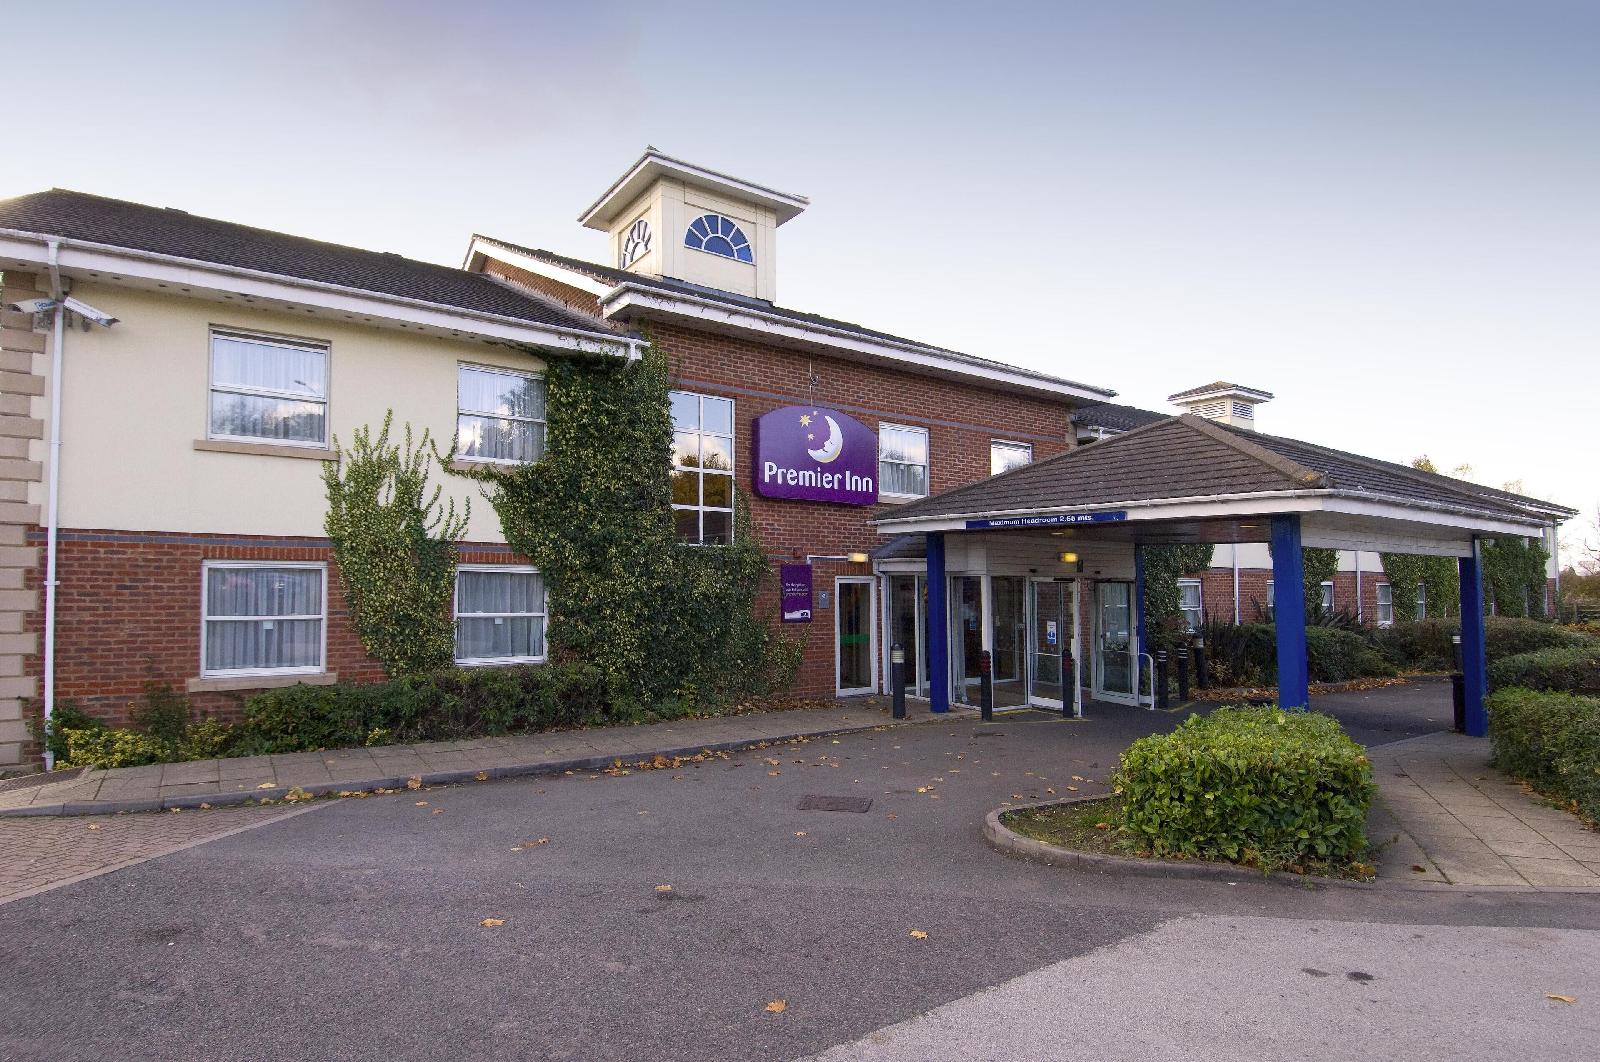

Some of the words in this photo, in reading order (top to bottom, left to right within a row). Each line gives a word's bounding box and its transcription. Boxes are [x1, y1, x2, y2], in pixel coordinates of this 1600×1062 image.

[764, 461, 842, 490] Premier
[845, 470, 873, 492] Inn
[1021, 517, 1058, 525] Headroom
